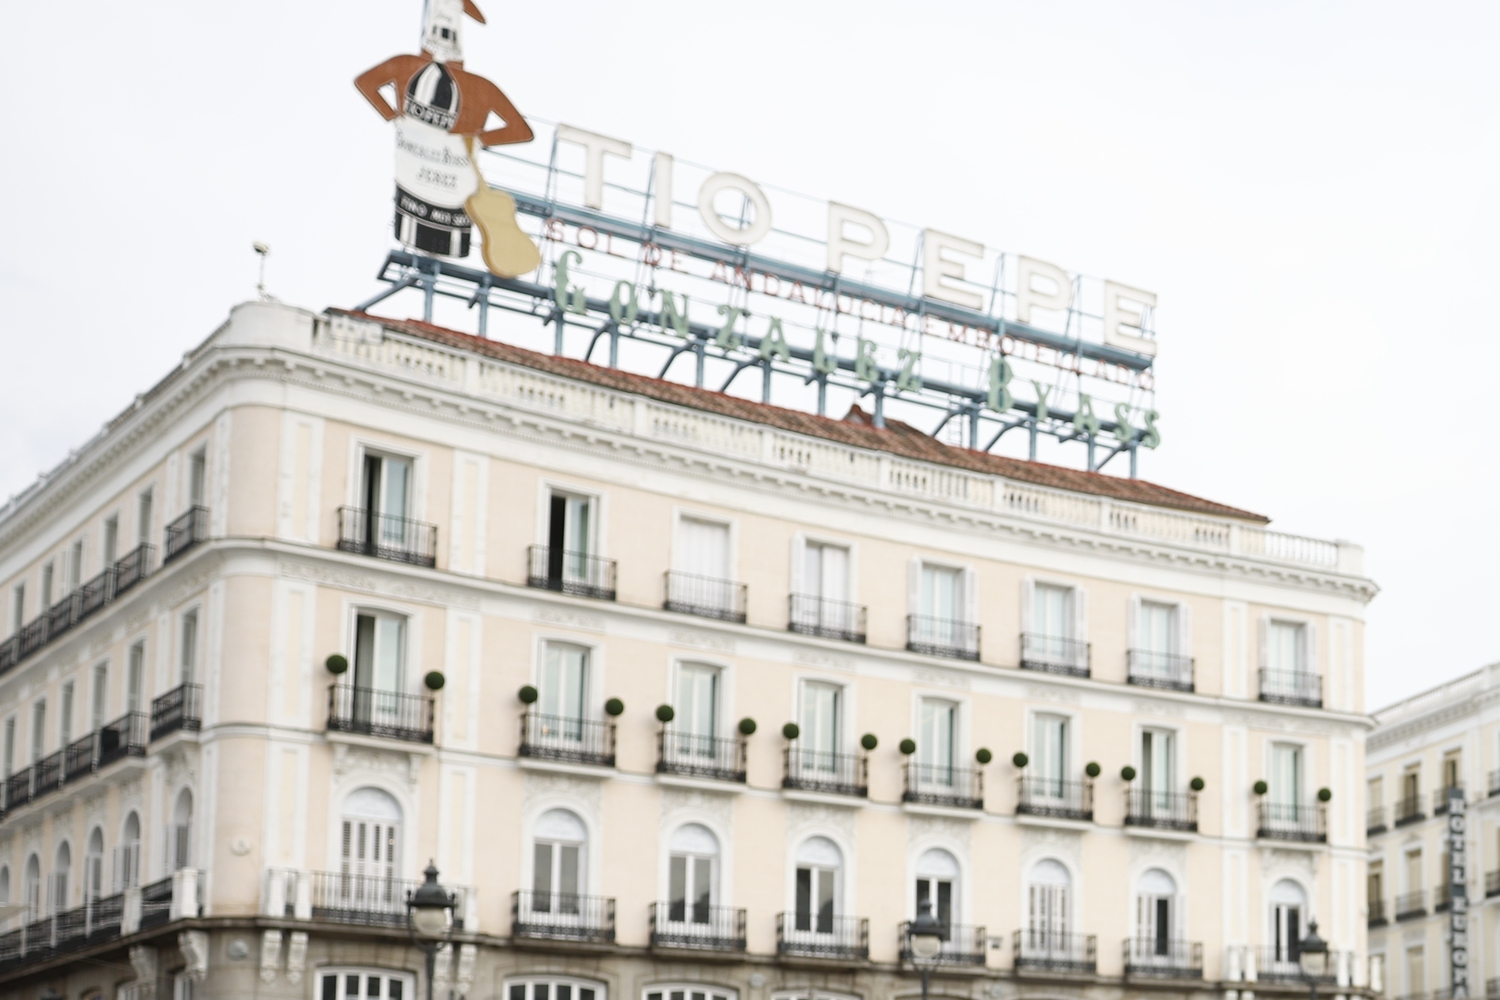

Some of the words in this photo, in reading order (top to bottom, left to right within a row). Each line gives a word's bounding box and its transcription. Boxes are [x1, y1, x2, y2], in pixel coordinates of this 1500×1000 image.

[545, 217, 628, 259] SOL
[643, 241, 691, 274] DE
[923, 313, 1156, 391] EMBOTELLADO
[557, 123, 772, 246] TIO
[828, 201, 1157, 356] PEPE
[554, 249, 923, 393] GONZALEZ
[987, 354, 1161, 450] BYASS
[1450, 797, 1466, 886] HOTEL
